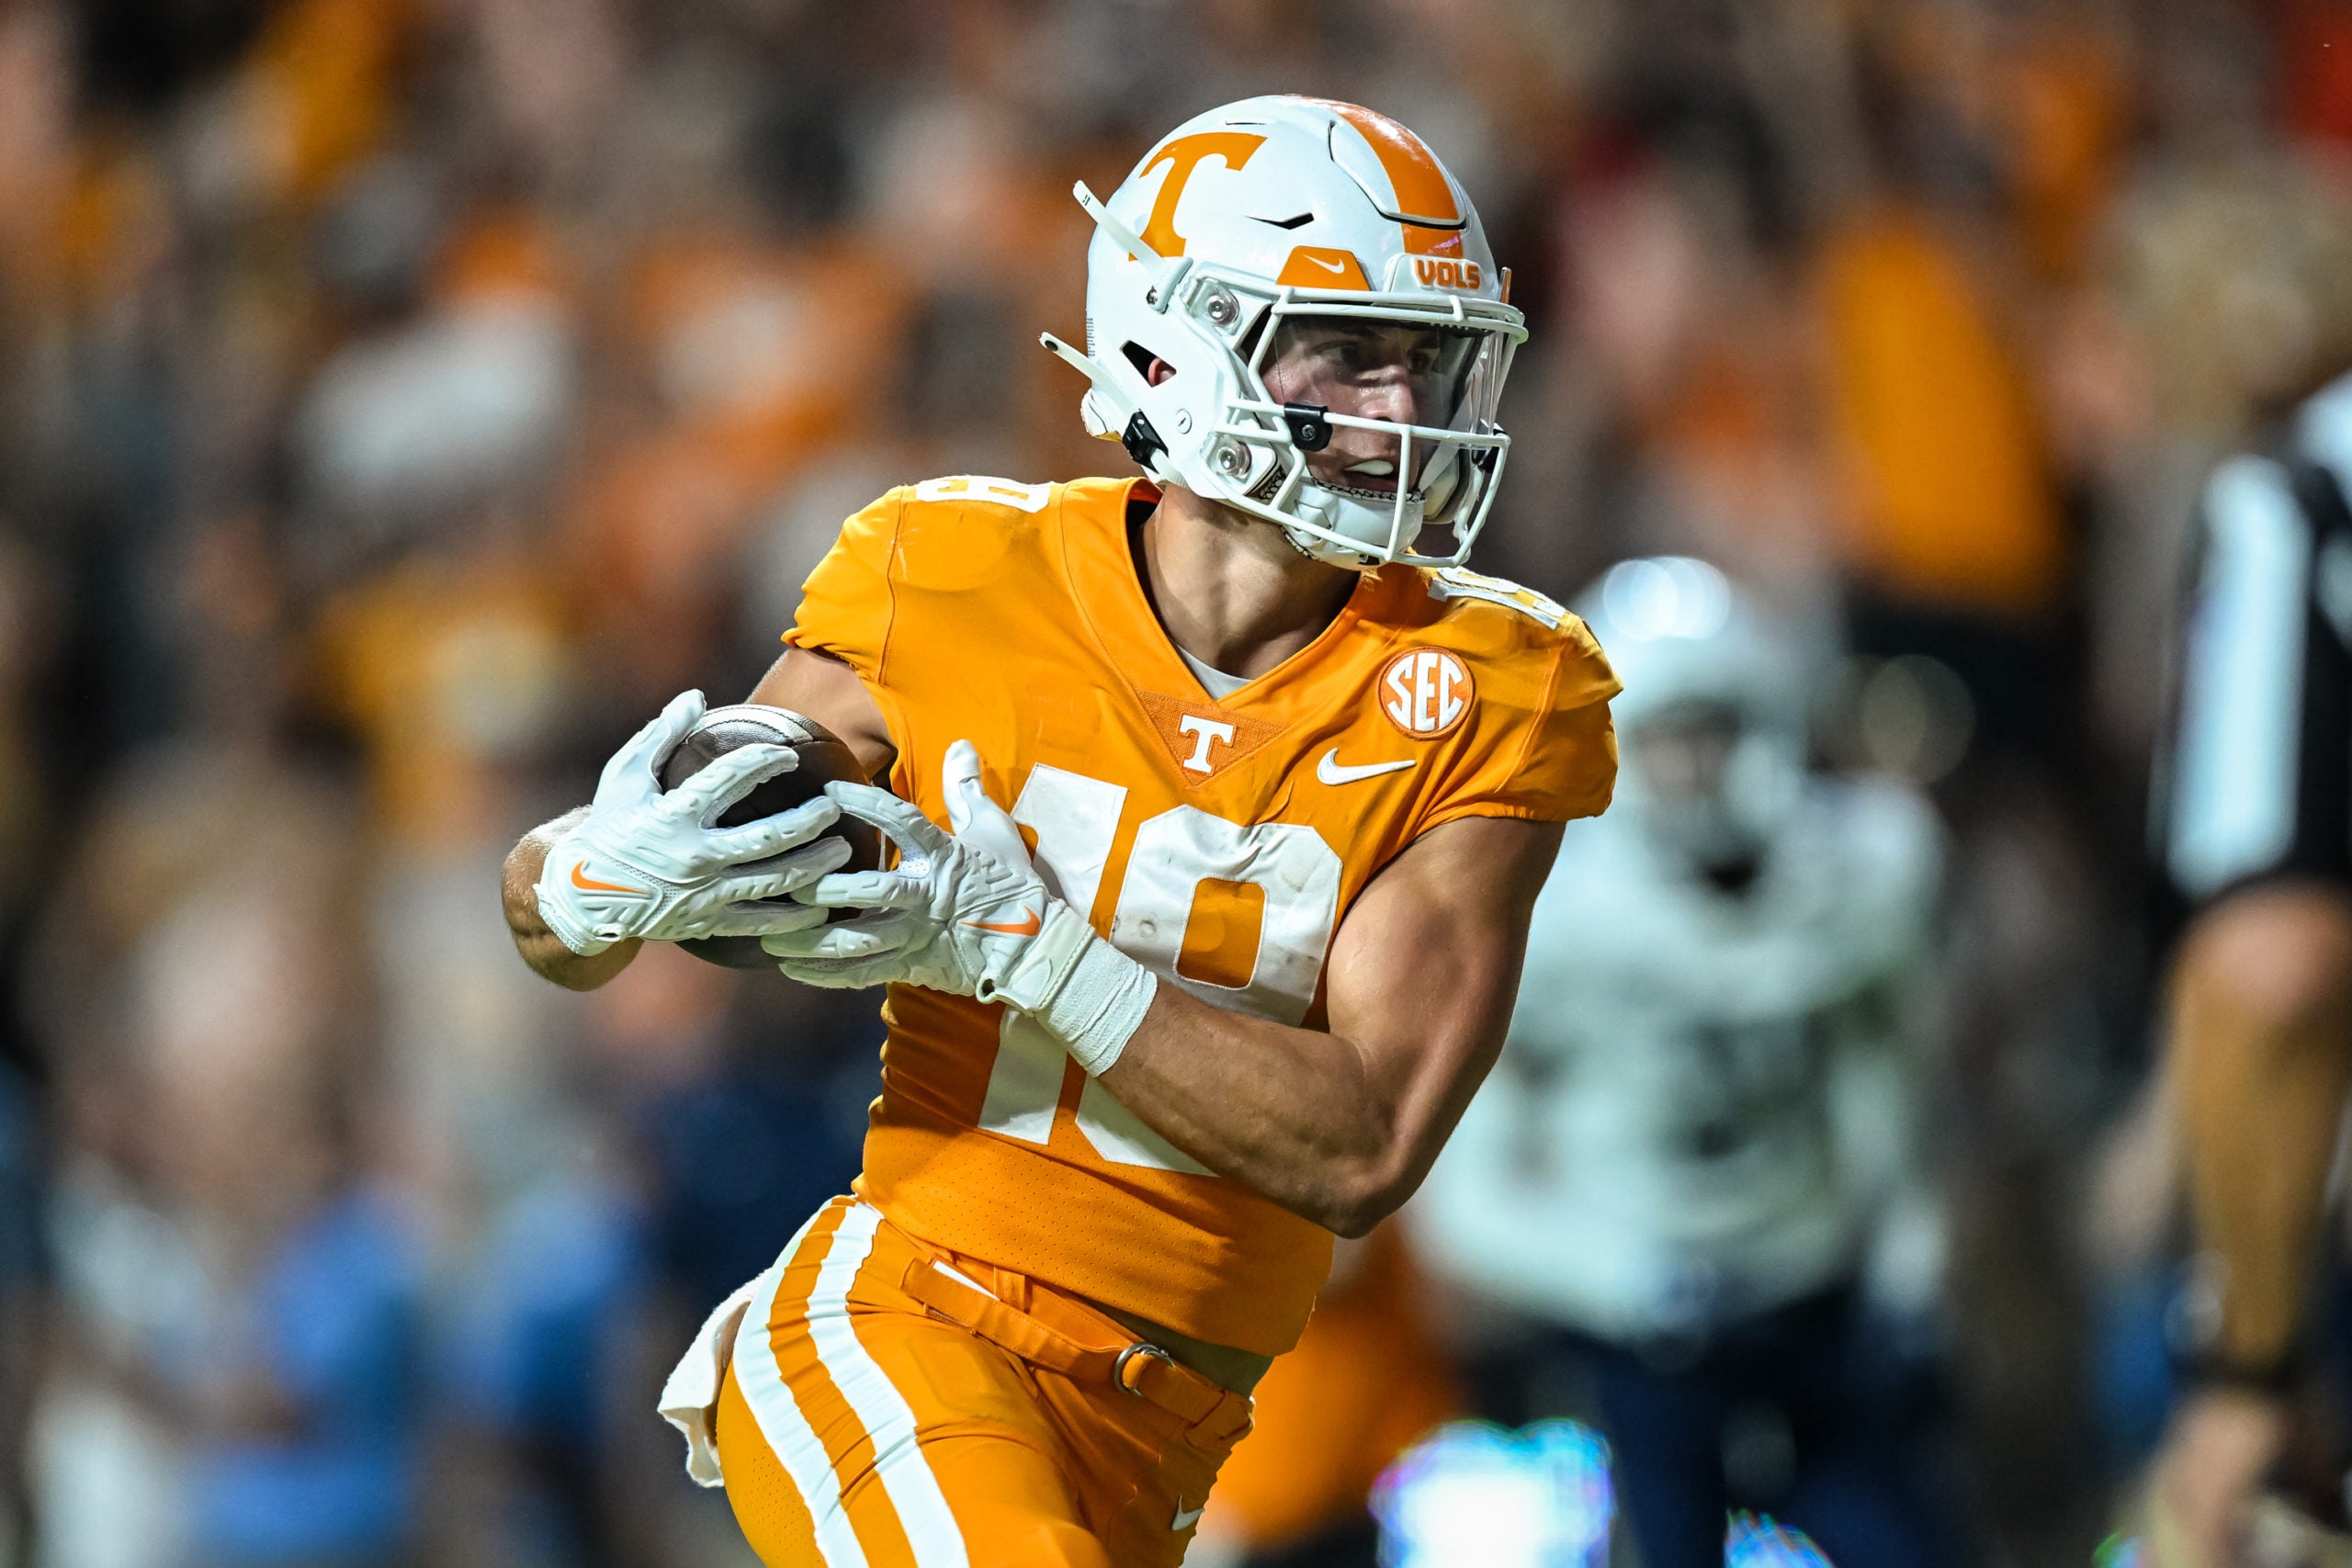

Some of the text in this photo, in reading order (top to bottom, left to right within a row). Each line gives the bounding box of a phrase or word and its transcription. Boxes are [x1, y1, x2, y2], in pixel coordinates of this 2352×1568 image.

[1128, 131, 1268, 262] T
[1416, 259, 1481, 289] VOLS
[1386, 652, 1464, 732] SEC
[1178, 713, 1238, 774] T
